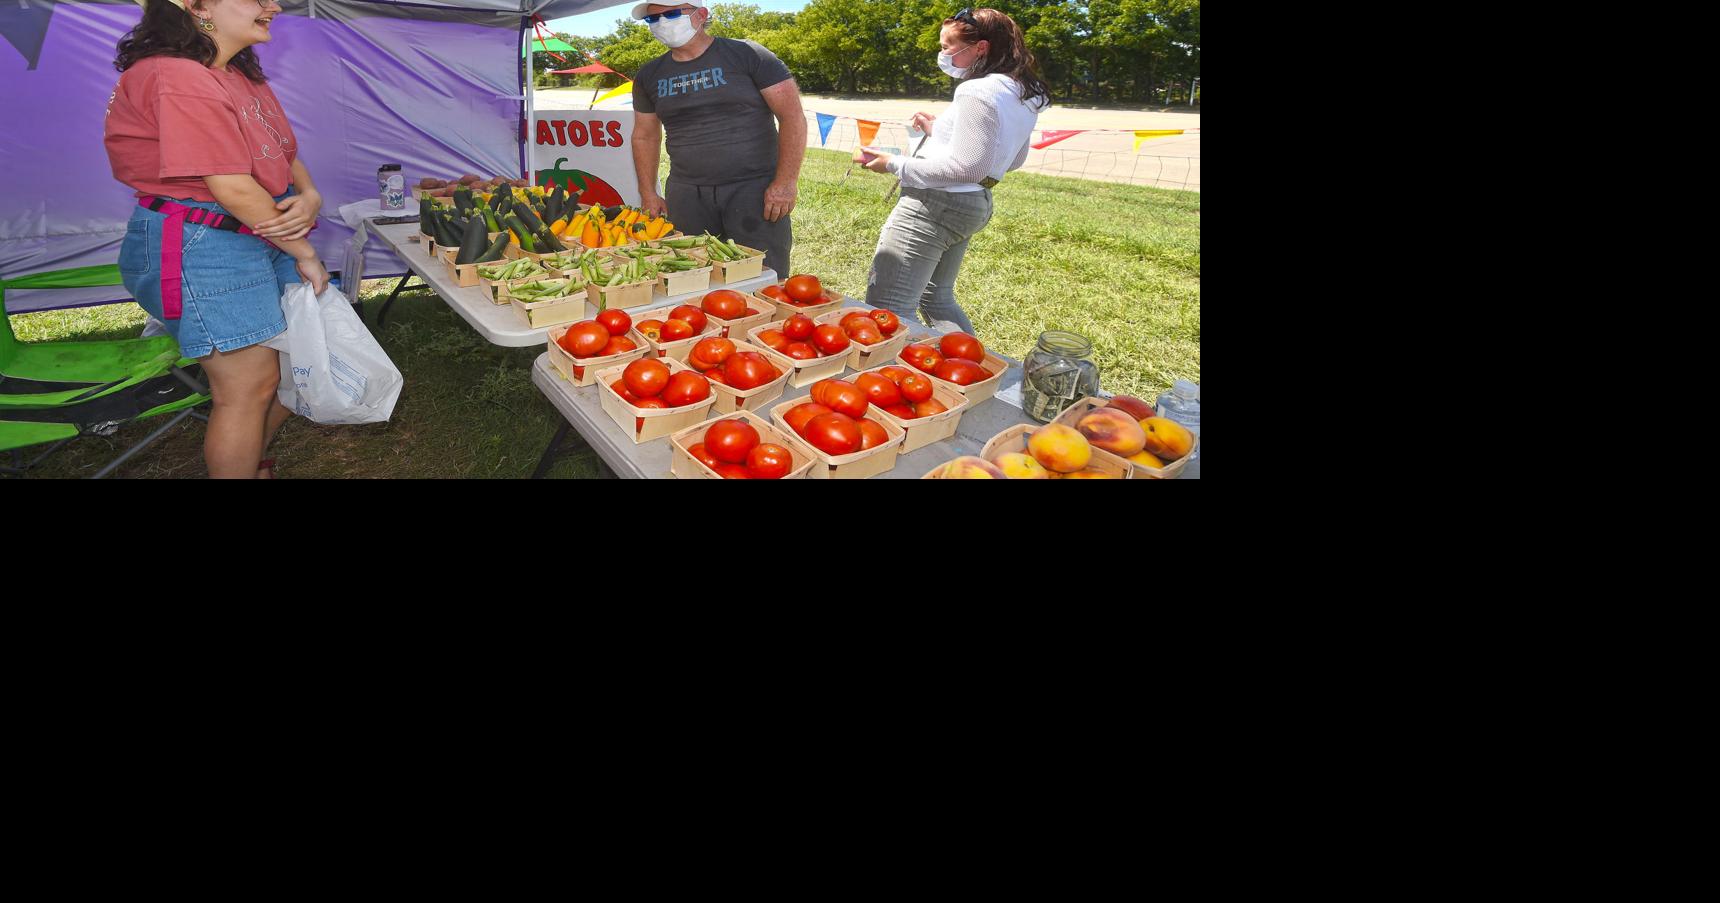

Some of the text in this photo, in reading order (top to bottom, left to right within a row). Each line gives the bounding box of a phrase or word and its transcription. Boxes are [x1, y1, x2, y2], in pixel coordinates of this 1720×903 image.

[657, 67, 728, 98] BETTER
[673, 76, 709, 88] TOGETHER
[524, 118, 624, 148] ATOES
[293, 366, 311, 378] Pay
